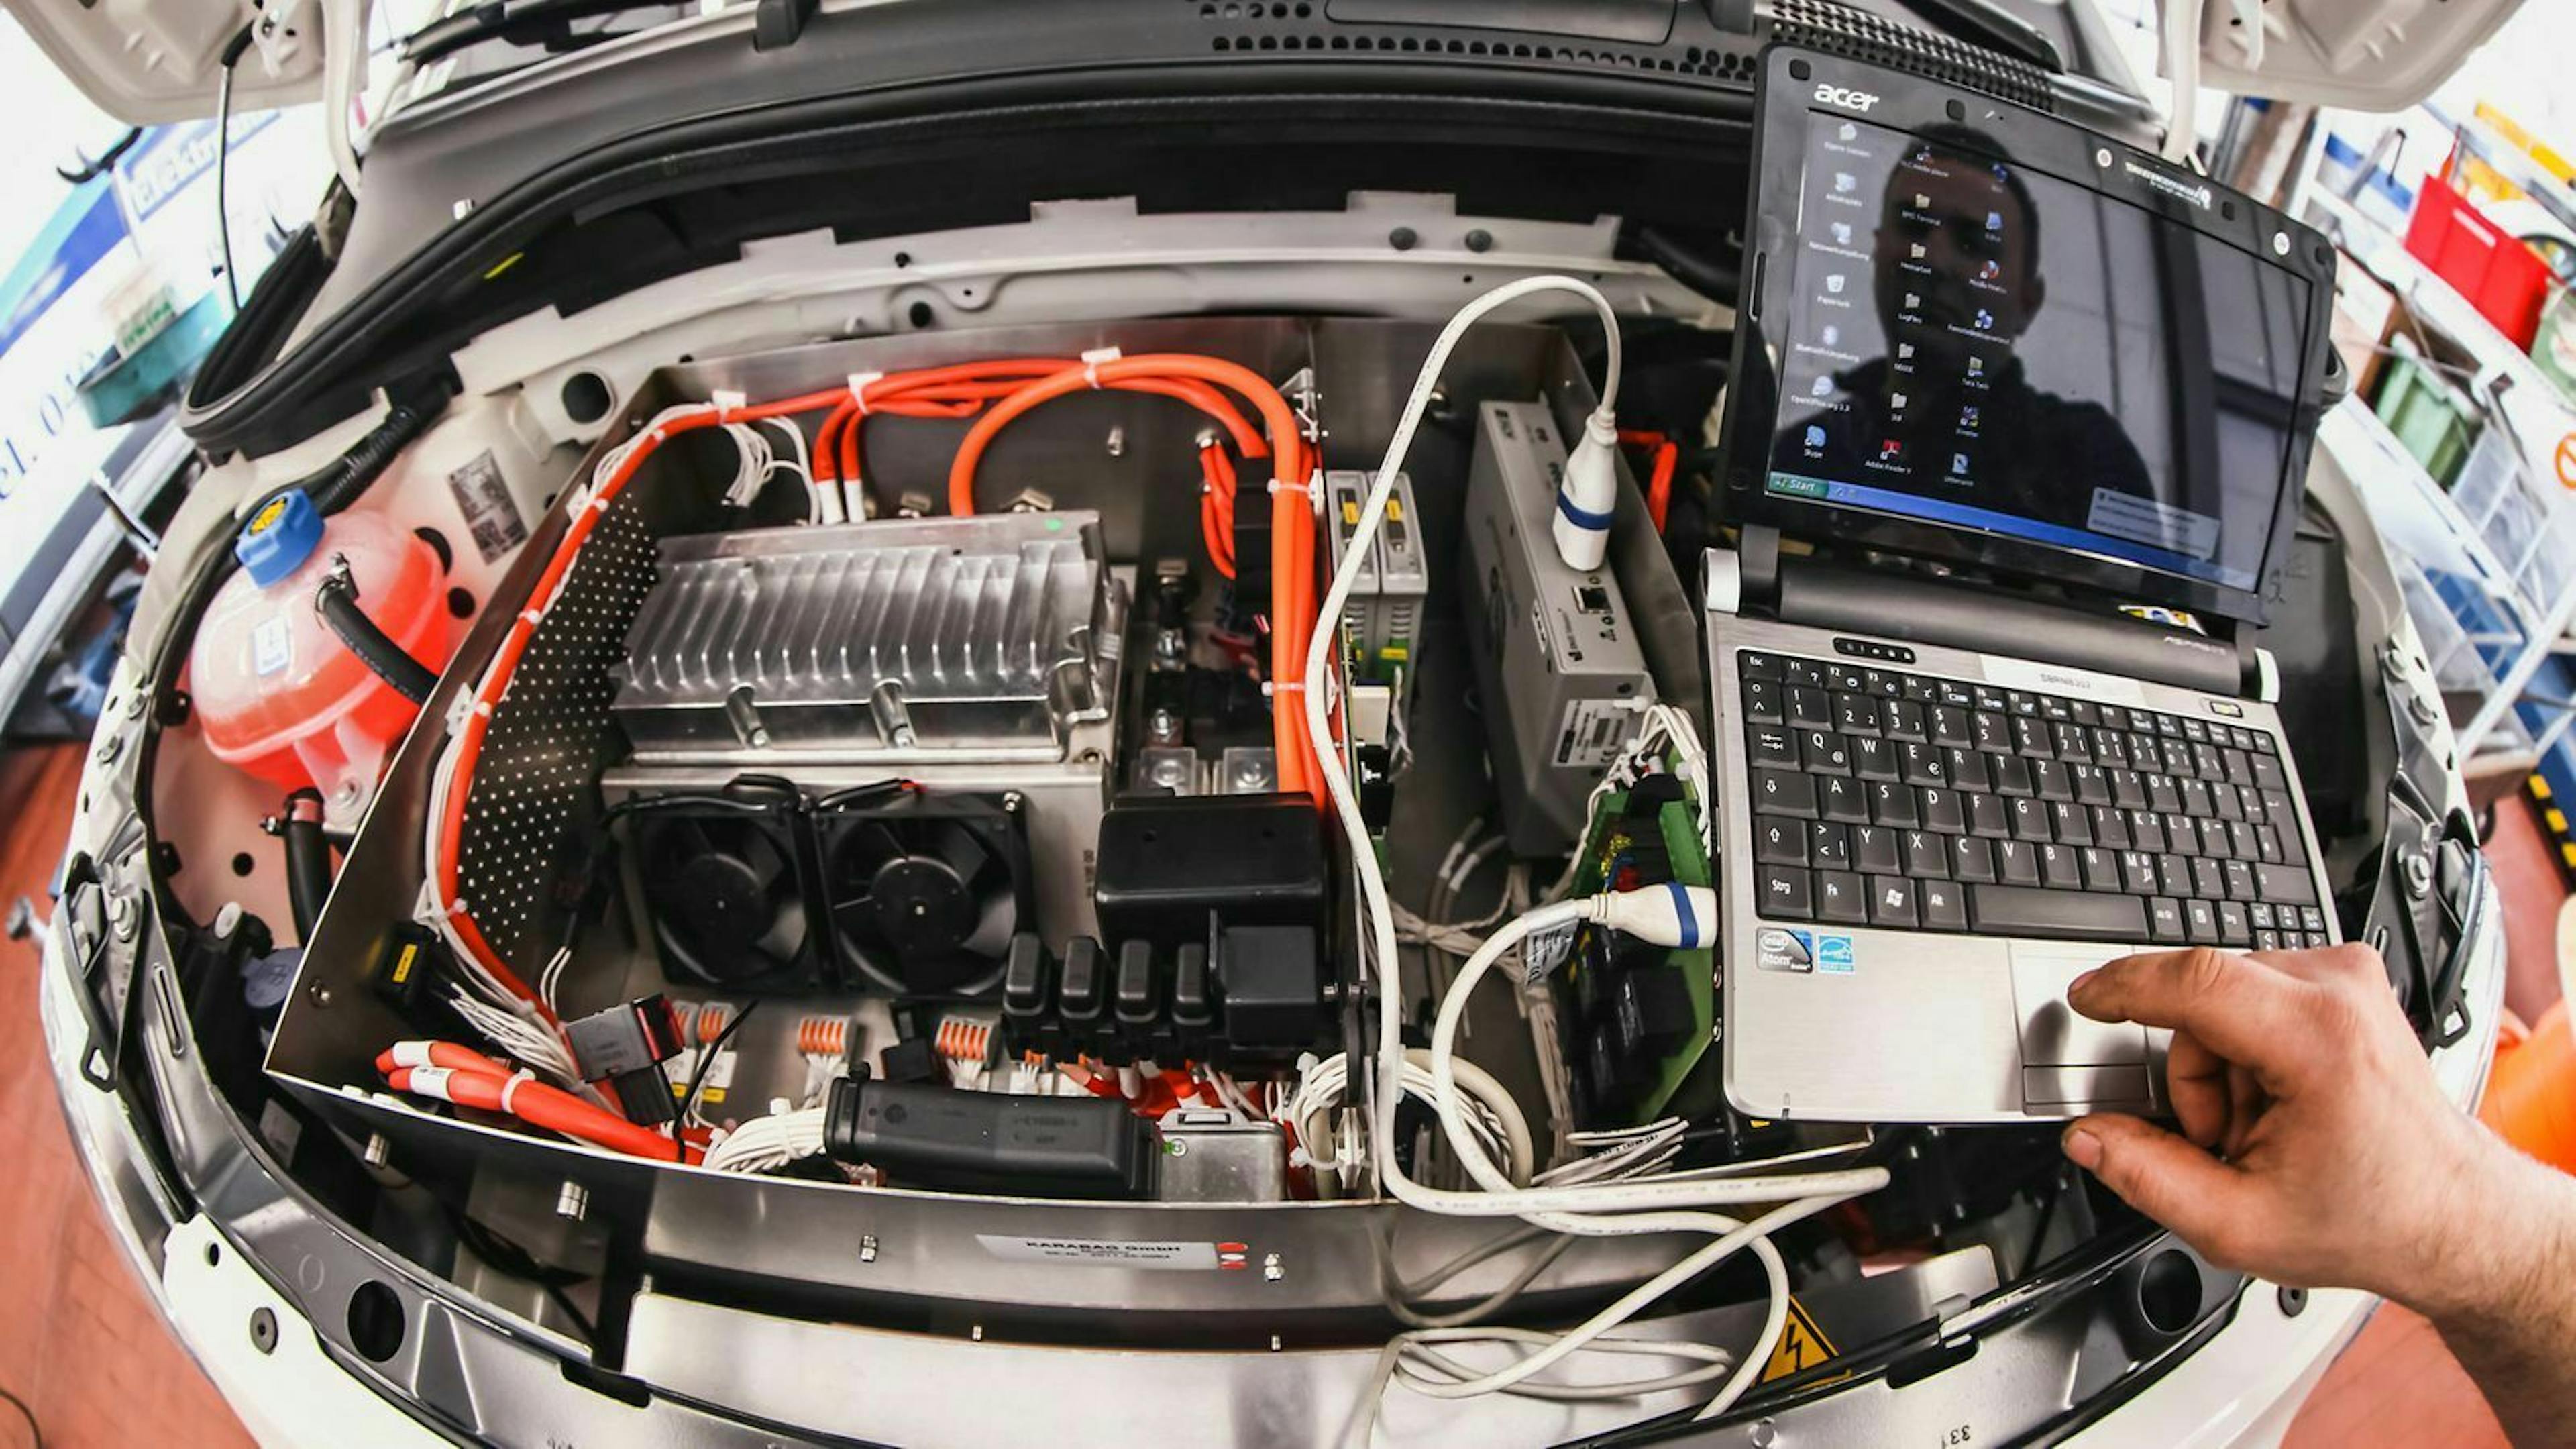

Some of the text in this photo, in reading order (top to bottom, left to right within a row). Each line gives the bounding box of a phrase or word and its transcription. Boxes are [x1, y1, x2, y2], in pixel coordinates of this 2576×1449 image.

[1813, 83, 1880, 112] acer
[1789, 479, 1816, 491] Start
[1845, 709, 1854, 722] 2
[1892, 715, 1901, 729] 3
[1980, 728, 1989, 741] 5
[1812, 733, 1824, 749] Q
[1862, 739, 1877, 753] W
[1908, 744, 1919, 759] E
[1953, 750, 1964, 764] R
[1996, 755, 2006, 769] T
[2039, 761, 2047, 775] Z
[2077, 765, 2088, 778] U
[1831, 779, 1843, 794] A
[1880, 784, 1890, 798] S
[1927, 790, 1939, 804] D
[1973, 795, 1981, 808] F
[2017, 800, 2028, 814] G
[2058, 804, 2069, 818] H
[2134, 812, 2144, 825] K
[2168, 816, 2178, 830] L
[1861, 828, 1872, 843] Y
[1911, 833, 1923, 849] X
[1958, 839, 1969, 853] C
[2003, 842, 2014, 857] V
[2045, 846, 2055, 861] B
[2087, 849, 2098, 864] N
[2125, 853, 2138, 867] M
[1771, 878, 1792, 895] Strg
[1827, 883, 1838, 896] Fn
[1760, 952, 1790, 966] Atom
[1026, 1241, 1119, 1250] KARABAG
